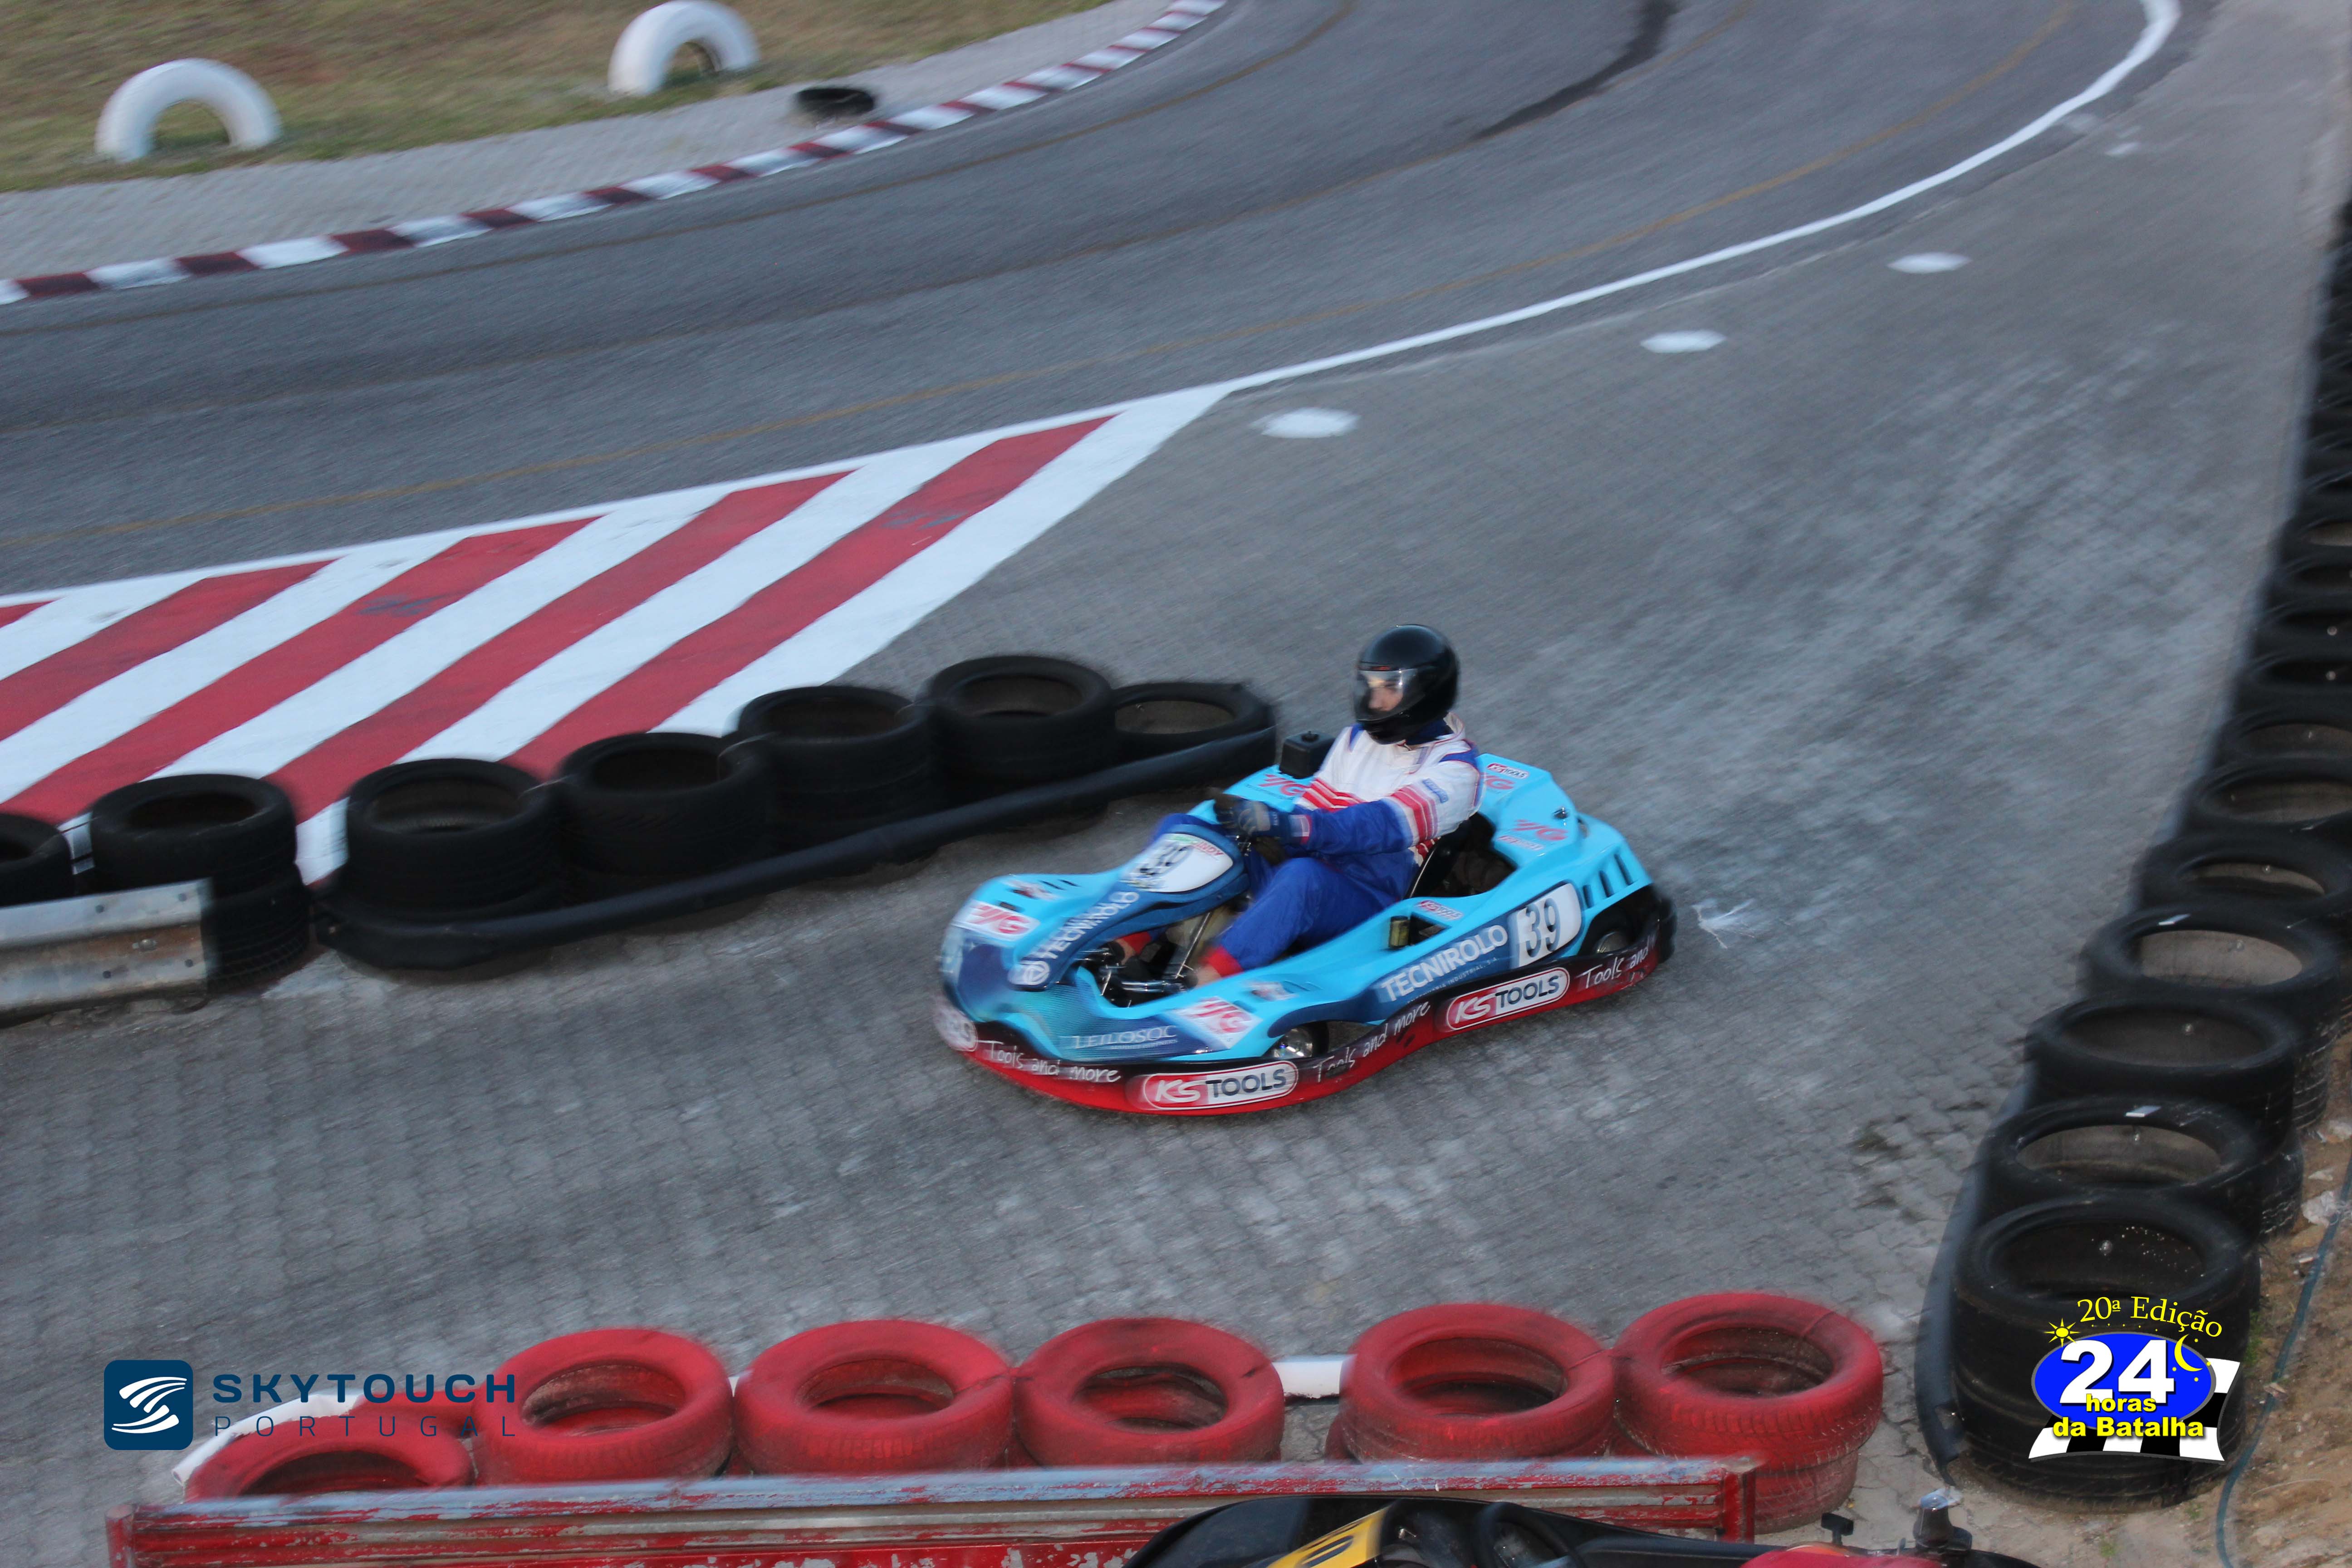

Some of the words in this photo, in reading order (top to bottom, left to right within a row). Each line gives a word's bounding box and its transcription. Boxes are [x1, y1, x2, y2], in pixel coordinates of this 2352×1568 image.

[1526, 898, 1561, 957] 39
[1381, 925, 1508, 1001] TECNIROLO
[1576, 956, 1625, 989] Tools
[1629, 936, 1650, 969] and
[1455, 993, 1496, 1024] KS
[1495, 975, 1559, 1008] TOOLS
[1363, 1023, 1388, 1058] and
[1394, 1001, 1431, 1035] more
[978, 1040, 1024, 1069] Tools
[1029, 1059, 1060, 1076] and
[1072, 1066, 1122, 1083] more
[1156, 1079, 1207, 1102] KS
[1205, 1068, 1287, 1098] TOOLS
